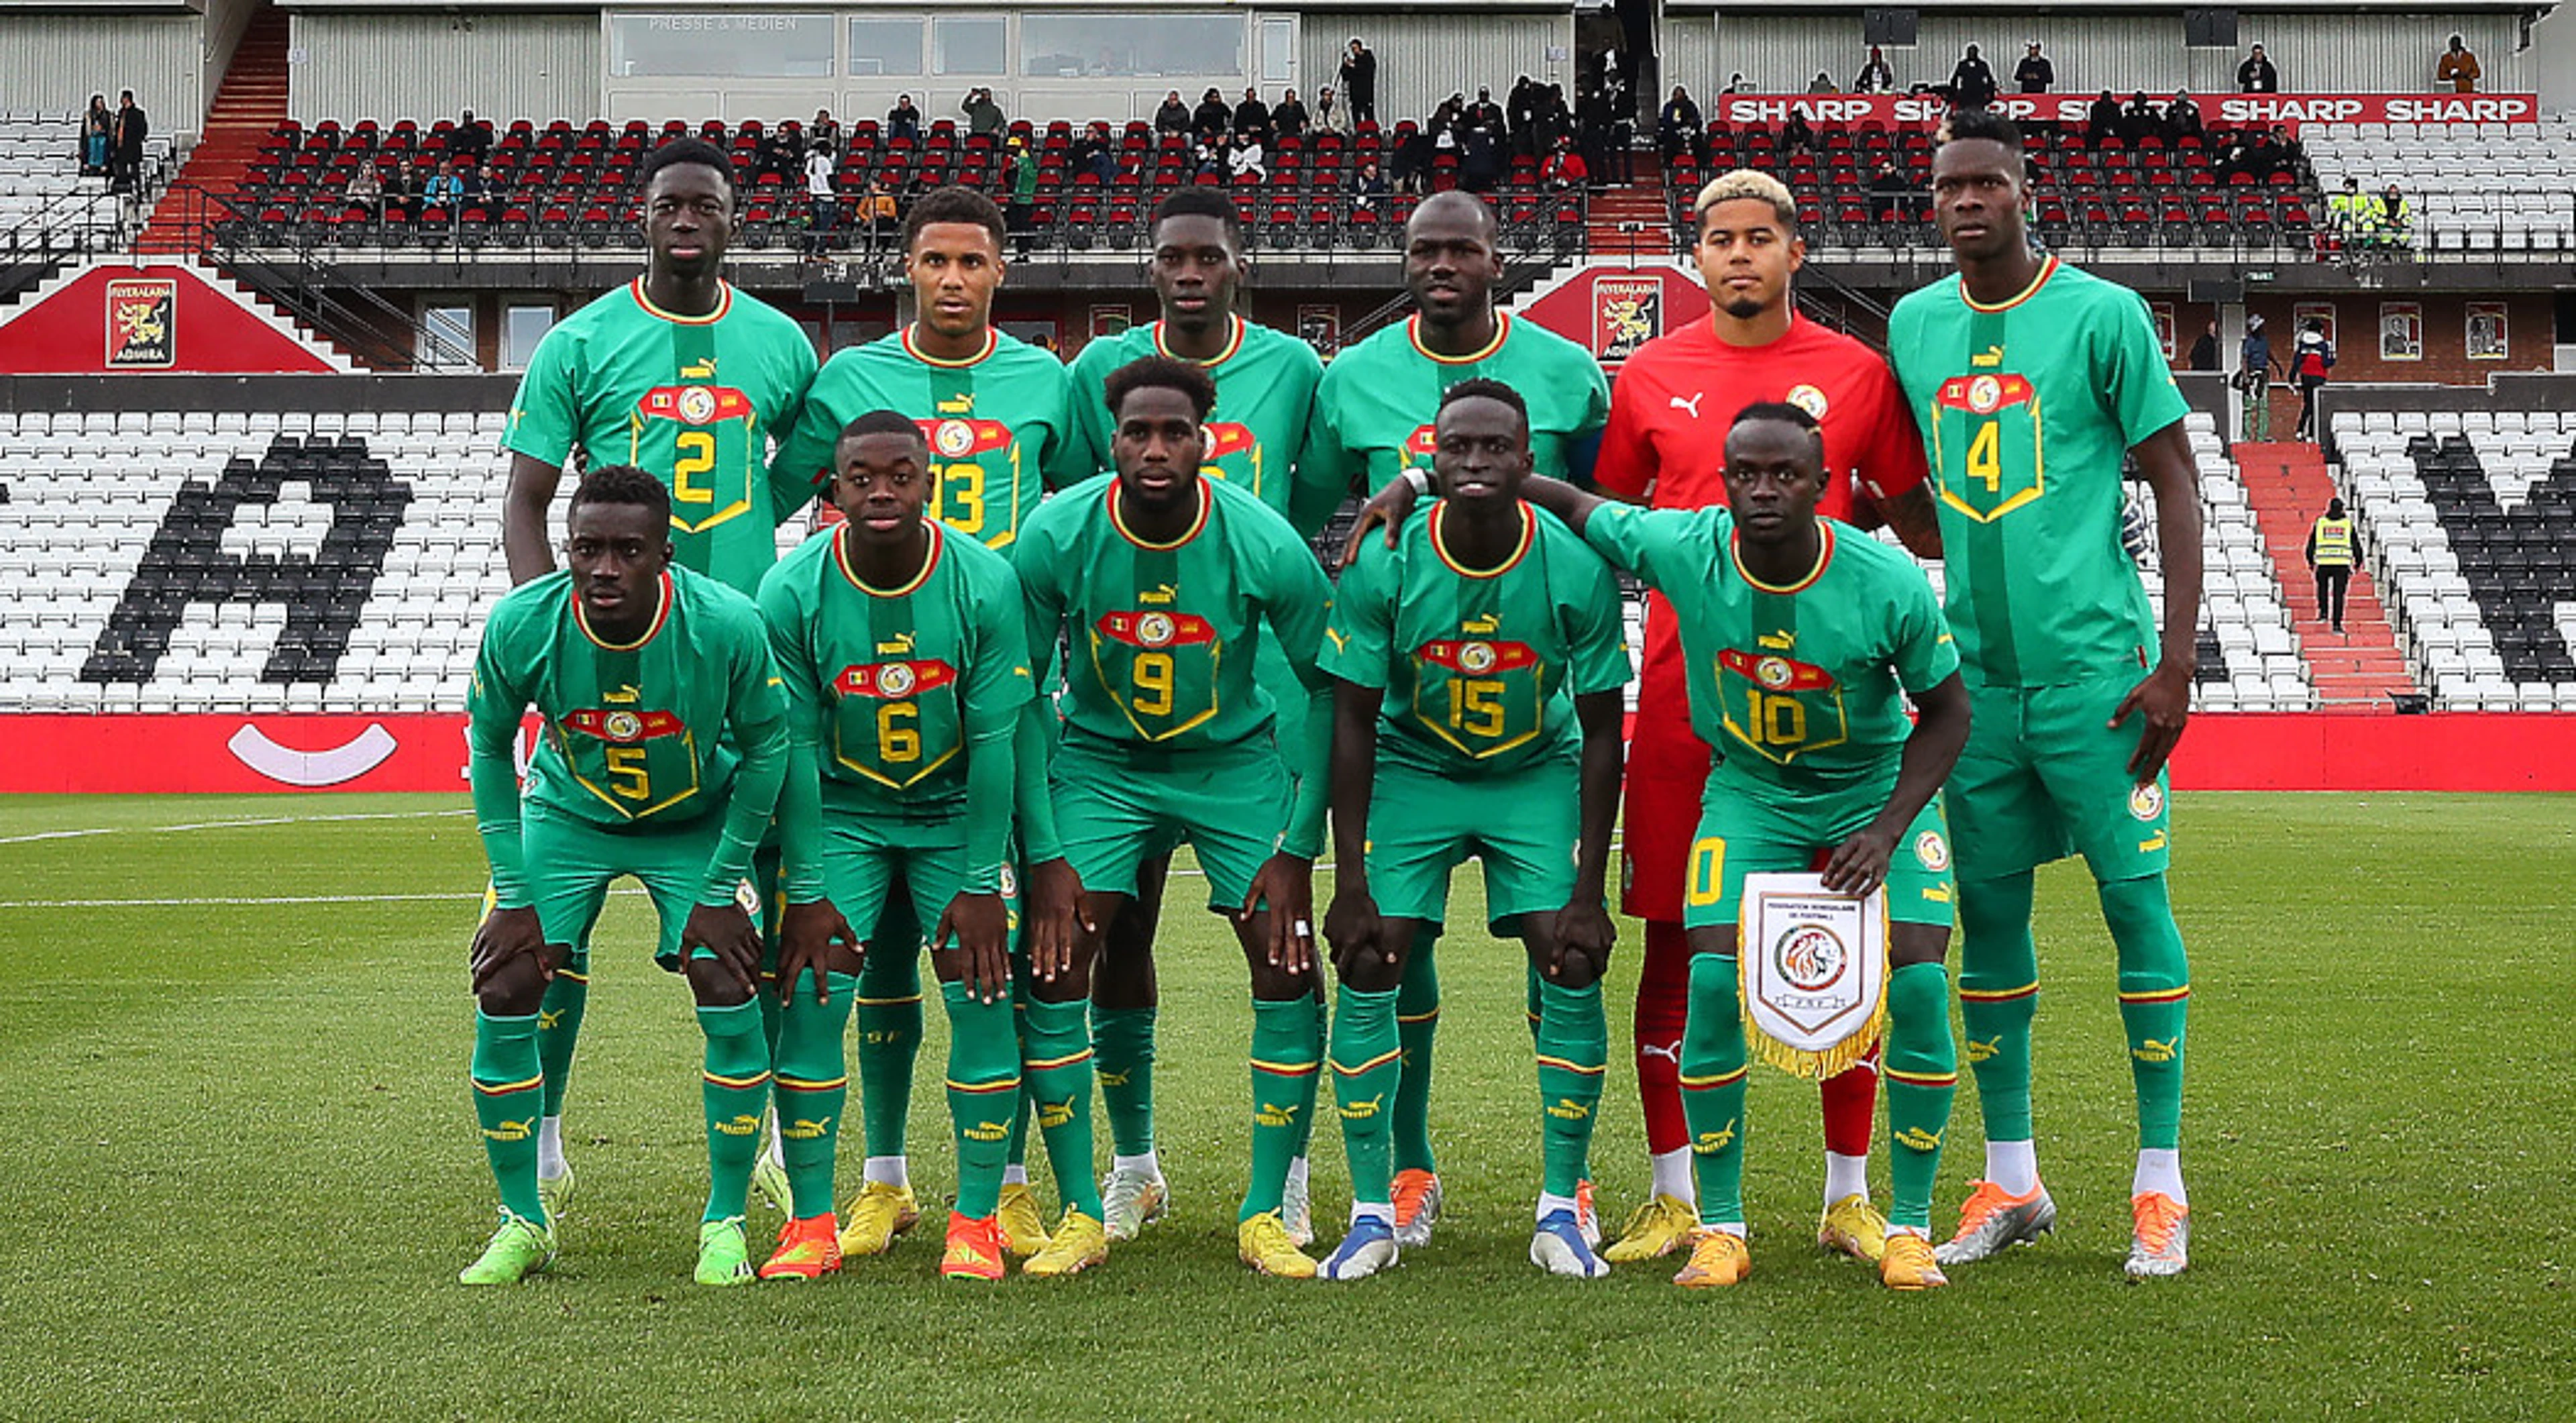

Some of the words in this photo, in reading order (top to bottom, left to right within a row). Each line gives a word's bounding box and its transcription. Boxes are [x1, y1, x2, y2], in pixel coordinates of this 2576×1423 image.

[649, 17, 713, 30] PRESSE
[1729, 100, 1872, 122] SHARP
[1894, 100, 2036, 121] SHP
[2220, 99, 2364, 121] SHARP
[2385, 99, 2528, 121] SHARP
[674, 431, 715, 503] 2
[1966, 421, 2001, 492] 4
[926, 463, 985, 534] 13
[1133, 651, 1174, 717] 9
[1447, 678, 1506, 737] 15
[877, 701, 921, 763] 6
[1746, 688, 1807, 745] 10
[606, 747, 649, 801] 5
